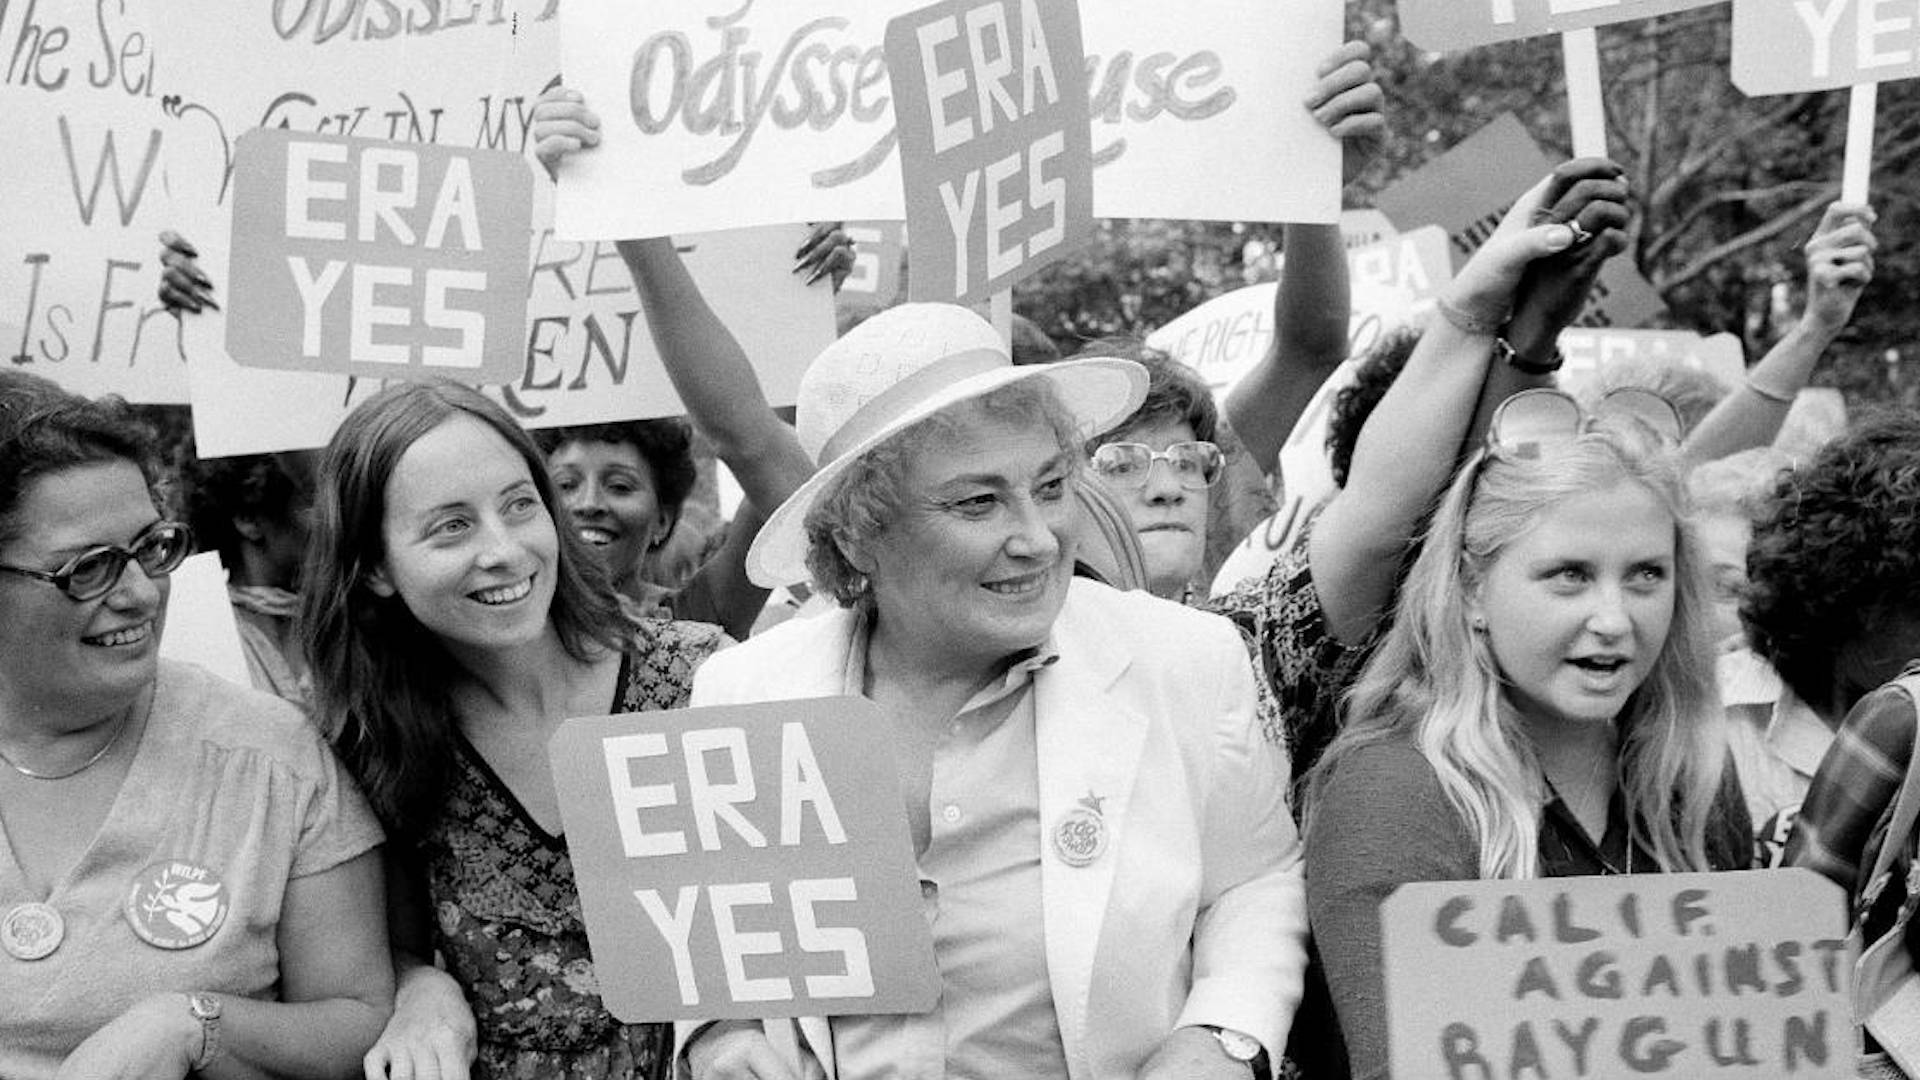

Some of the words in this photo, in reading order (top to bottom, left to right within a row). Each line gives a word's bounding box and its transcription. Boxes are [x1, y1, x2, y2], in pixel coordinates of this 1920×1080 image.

[916, 0, 1061, 154] ERA
[1794, 0, 1920, 78] YE
[630, 17, 899, 188] Odysse
[285, 141, 484, 251] ERA
[938, 130, 1066, 300] YES
[11, 253, 73, 365] Is
[286, 255, 488, 369] YES
[602, 722, 848, 859] ERA
[634, 877, 876, 1006] YES
[1434, 889, 1717, 948] CALIF.
[1440, 1010, 1830, 1080] RAYGUN
